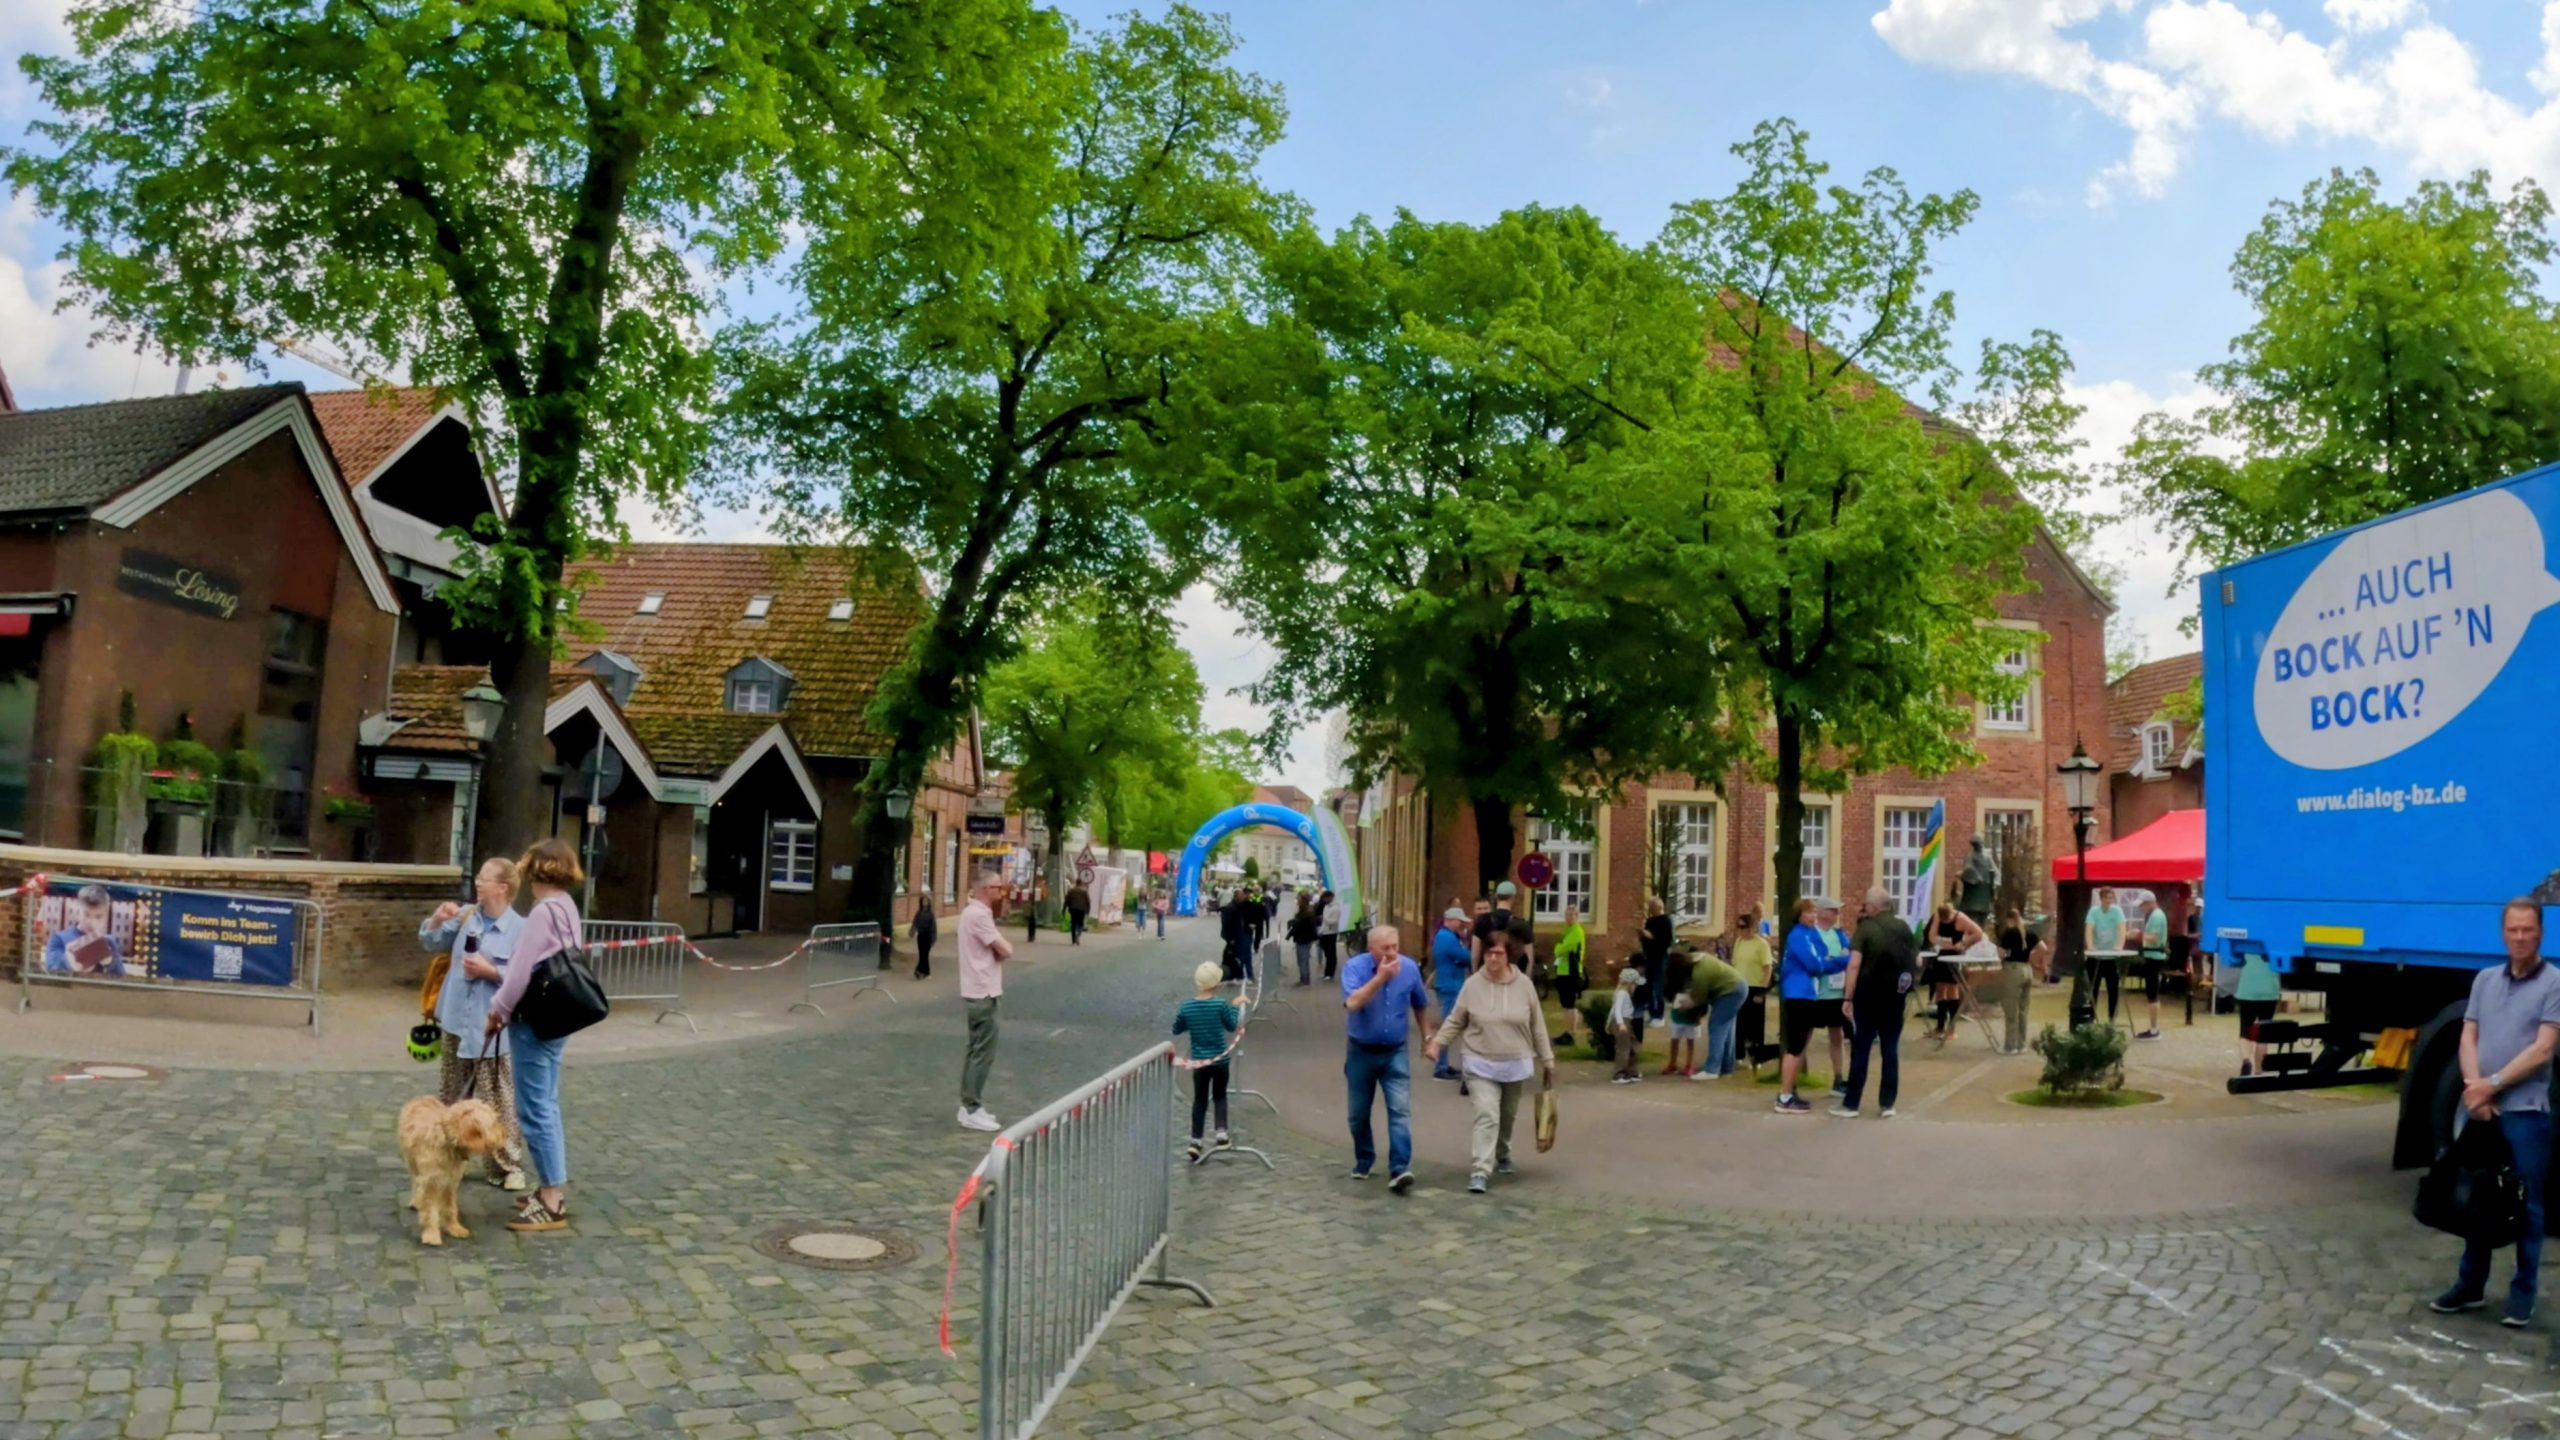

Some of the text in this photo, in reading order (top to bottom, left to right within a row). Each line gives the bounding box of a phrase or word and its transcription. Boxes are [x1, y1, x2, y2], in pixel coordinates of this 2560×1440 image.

[174, 568, 239, 619] Lösing
[2355, 551, 2453, 611] AUCH
[2273, 631, 2366, 683] BOCK
[2373, 614, 2443, 665] AUF
[2310, 677, 2425, 731] BOCK?
[2297, 780, 2467, 813] www.dialog-bz.de
[180, 927, 278, 945] bewirb Dich jetzt!
[182, 913, 219, 927] Komm
[220, 917, 237, 928] ins
[239, 917, 269, 930] Team
